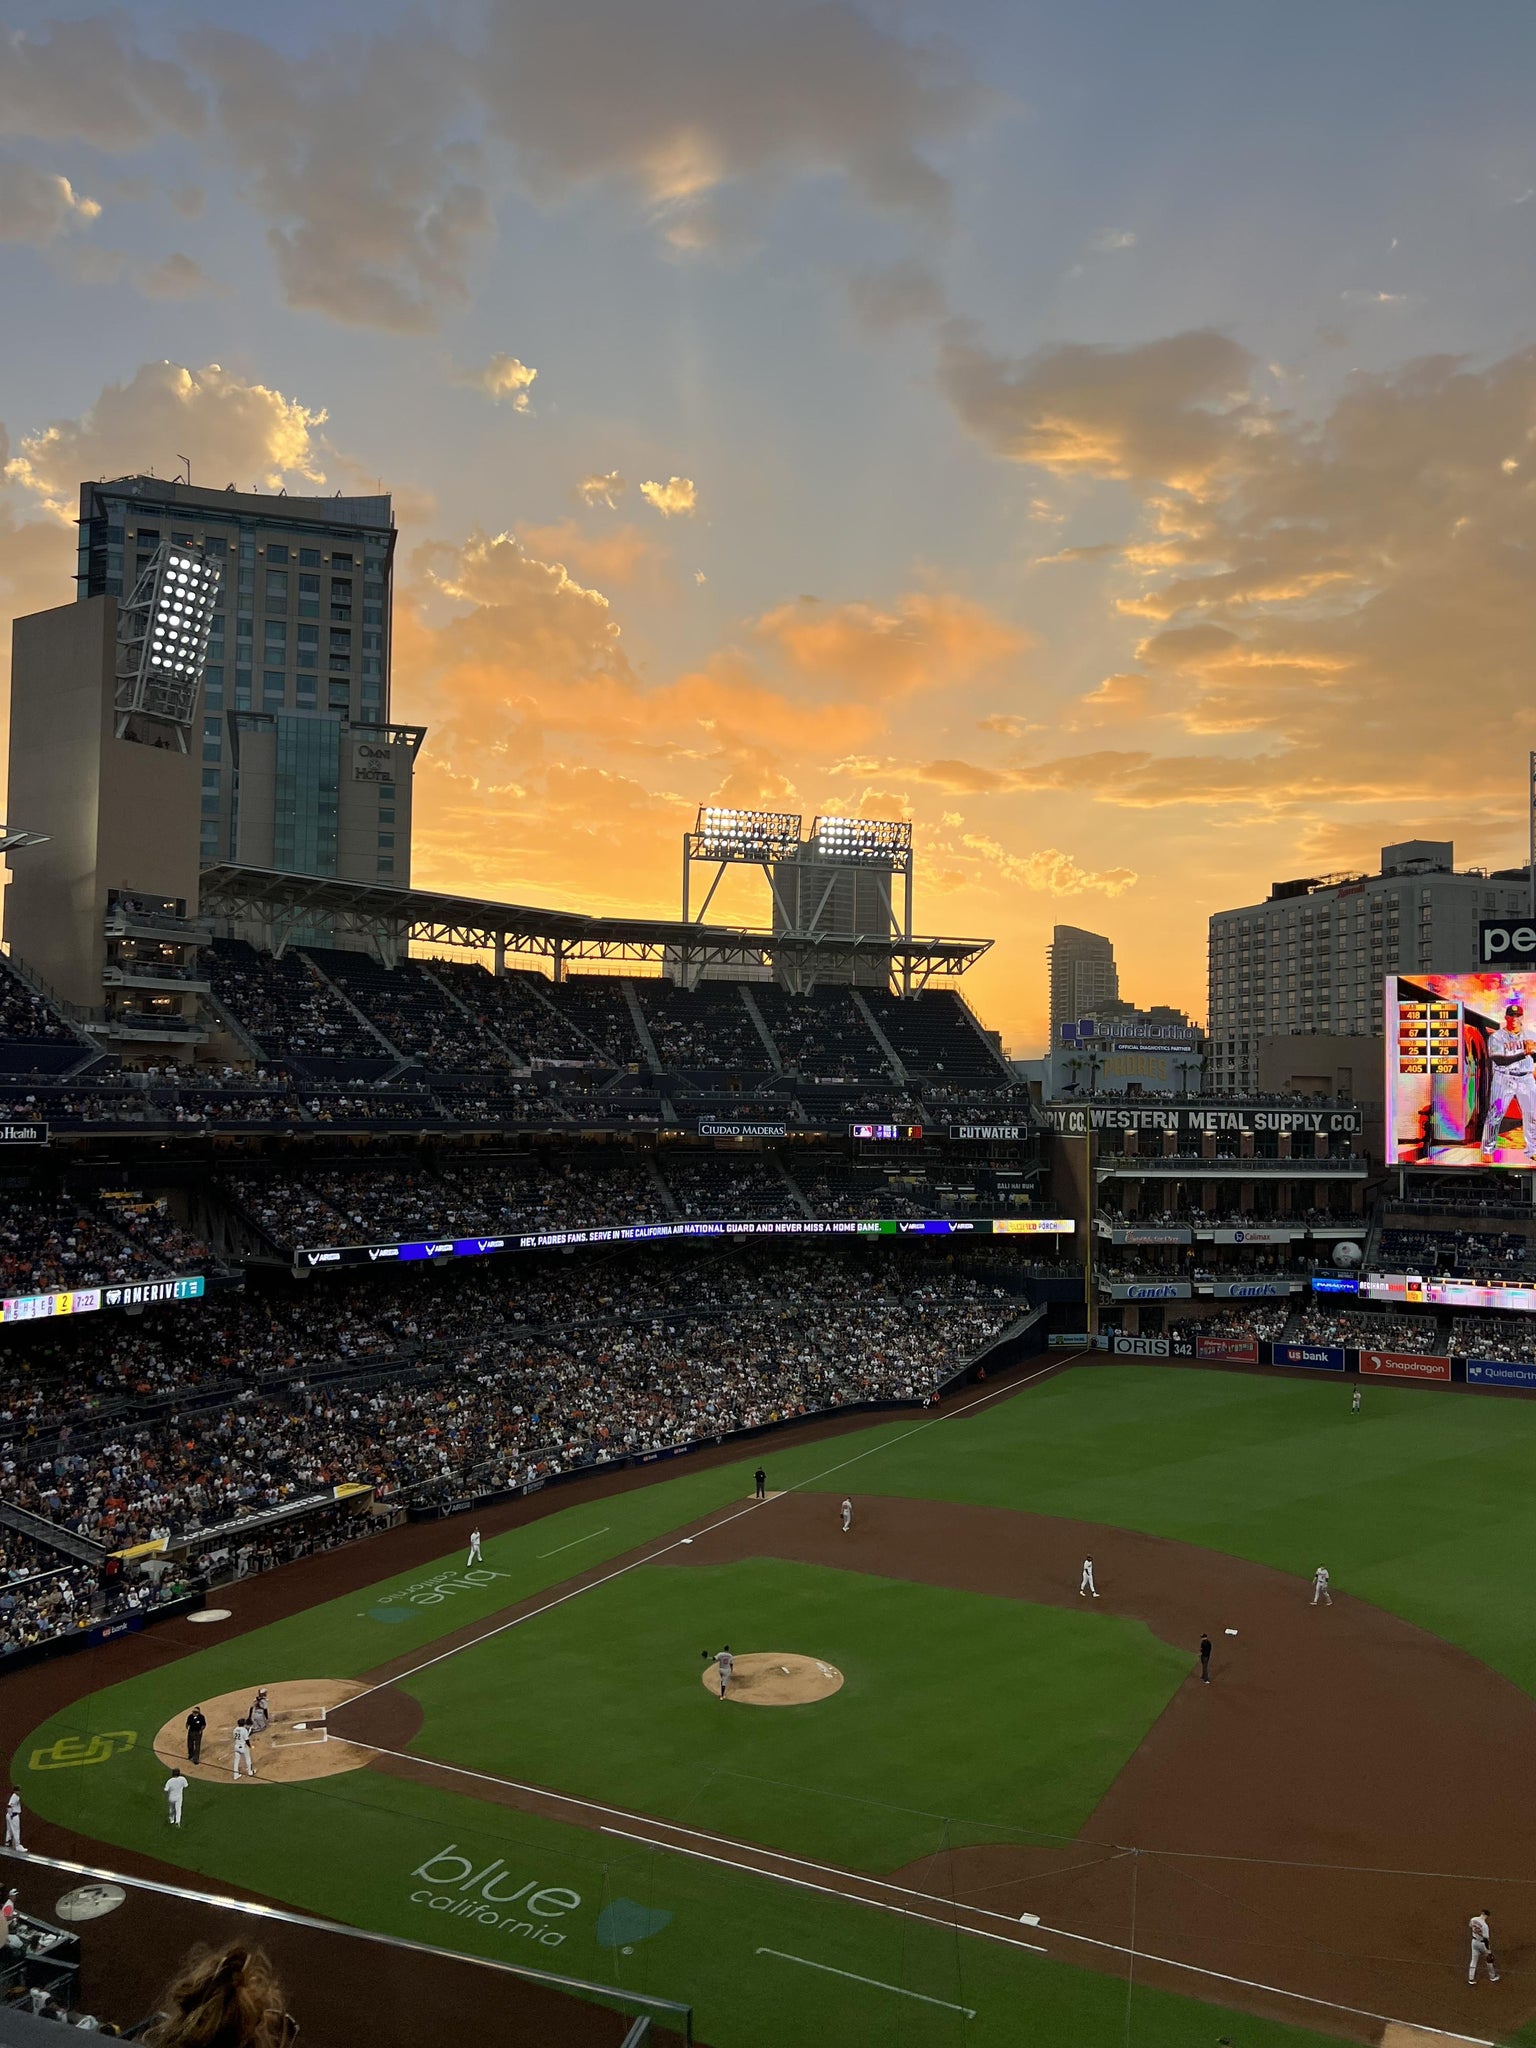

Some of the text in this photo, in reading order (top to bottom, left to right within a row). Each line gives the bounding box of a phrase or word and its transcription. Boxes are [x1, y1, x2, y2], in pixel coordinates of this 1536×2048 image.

[359, 744, 390, 760] OMNI
[355, 766, 393, 782] HOTEL
[1098, 1022, 1195, 1040] QuidelOrtho
[1102, 1054, 1168, 1081] PADRES
[1045, 1112, 1086, 1132] PLY CO.
[1090, 1110, 1360, 1132] WESTERN METAL SUPPLY CO.
[4, 1126, 37, 1139] Health
[701, 1125, 784, 1135] CIUDAD MADERAS
[960, 1127, 1019, 1139] CUTWATER
[520, 1222, 882, 1247] HEY, PADRES FANS. SERVE IN THE CALIFORNIA AIR NATIONAL GUARD AND NEVER MISS A HOME GAME.
[1245, 1232, 1270, 1240] Calimax
[124, 1282, 187, 1304] AMERIVET
[1127, 1284, 1177, 1297] Canel's
[1228, 1283, 1276, 1296] Canel's
[63, 1296, 67, 1307] 2
[77, 1295, 94, 1307] 7:22
[1116, 1338, 1167, 1354] ORIS
[1174, 1343, 1192, 1356] 342
[1289, 1350, 1328, 1362] us bank
[1385, 1359, 1444, 1373] Snapdragon
[376, 1571, 458, 1603] california
[410, 1570, 511, 1604] blue
[410, 1844, 581, 1917] blue
[410, 1890, 568, 1947] california
